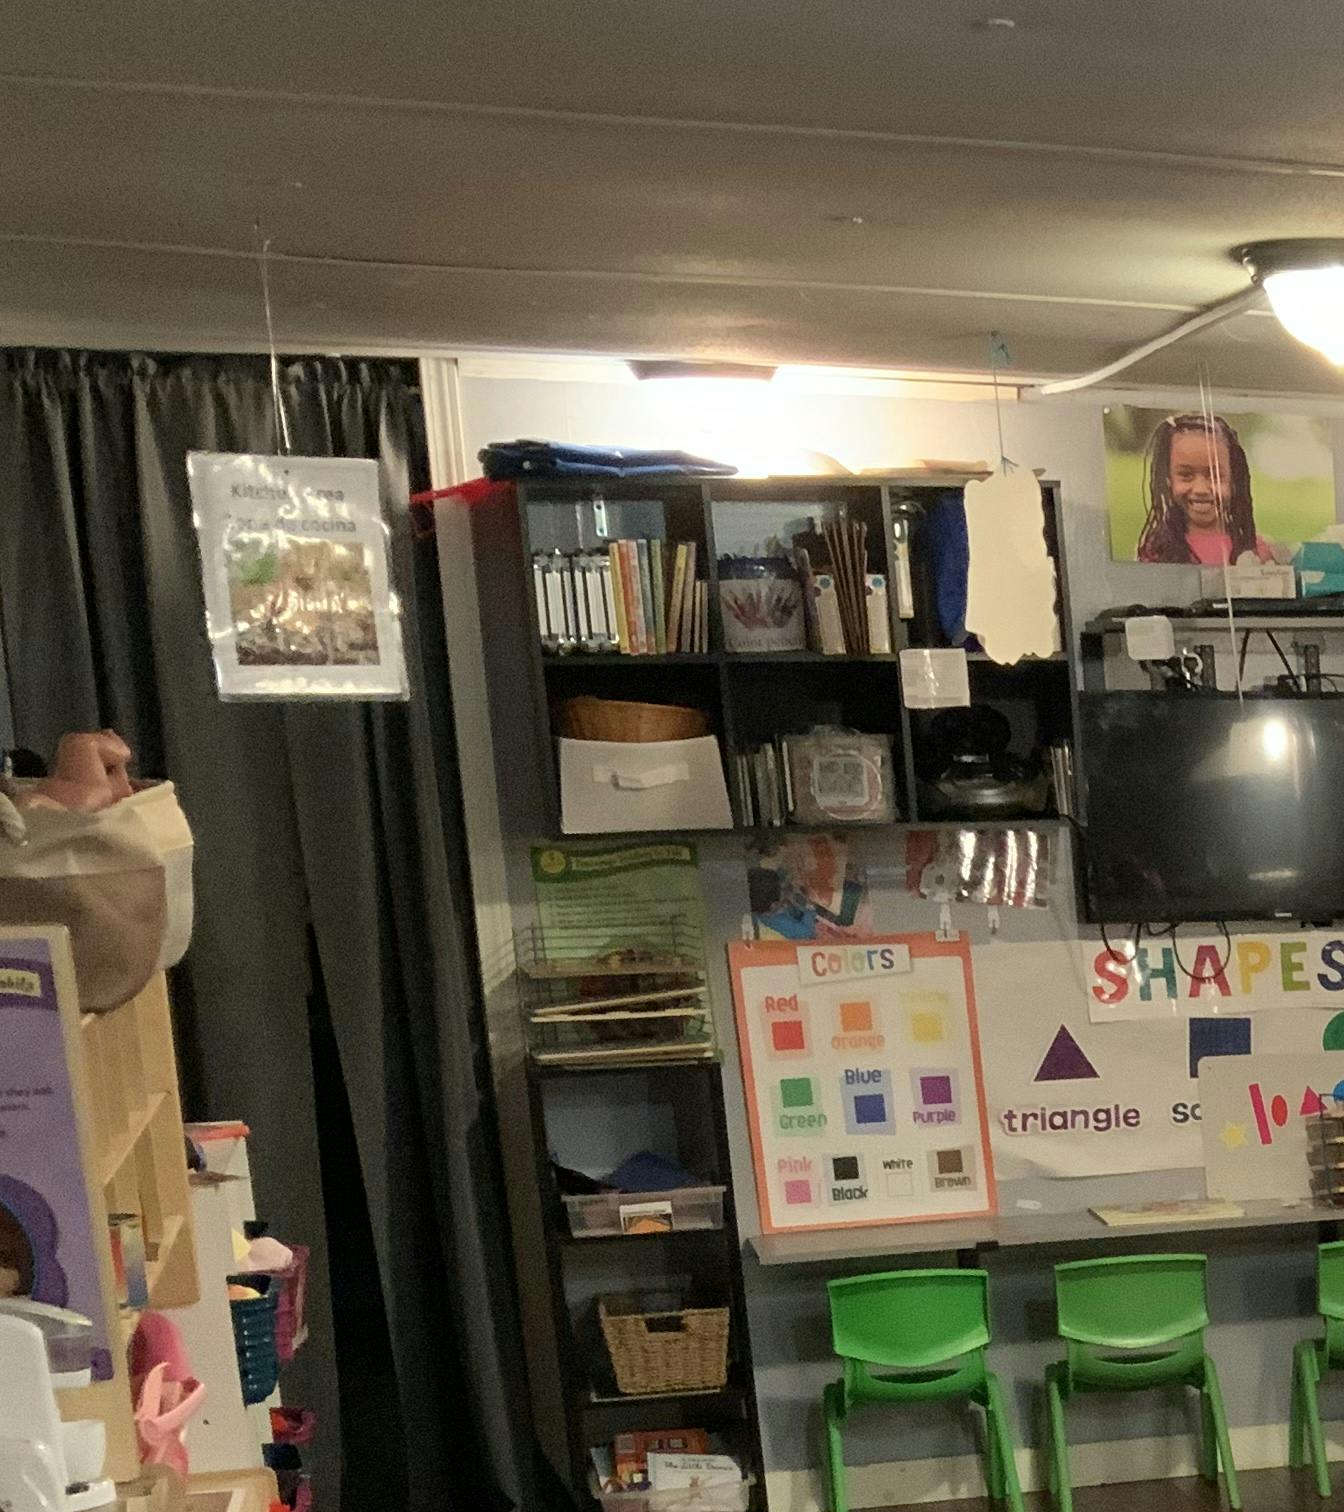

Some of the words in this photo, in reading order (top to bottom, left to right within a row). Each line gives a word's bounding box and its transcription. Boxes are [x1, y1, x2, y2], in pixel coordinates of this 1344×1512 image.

[301, 516, 357, 533] cocina
[811, 948, 895, 977] Colors
[765, 994, 799, 1014] Red
[844, 1068, 882, 1085] Blue
[779, 1111, 828, 1130] Green
[912, 1108, 956, 1125] Purple
[1003, 1104, 1142, 1133] triangle
[777, 1155, 812, 1174] Pink
[832, 1187, 869, 1201] Black
